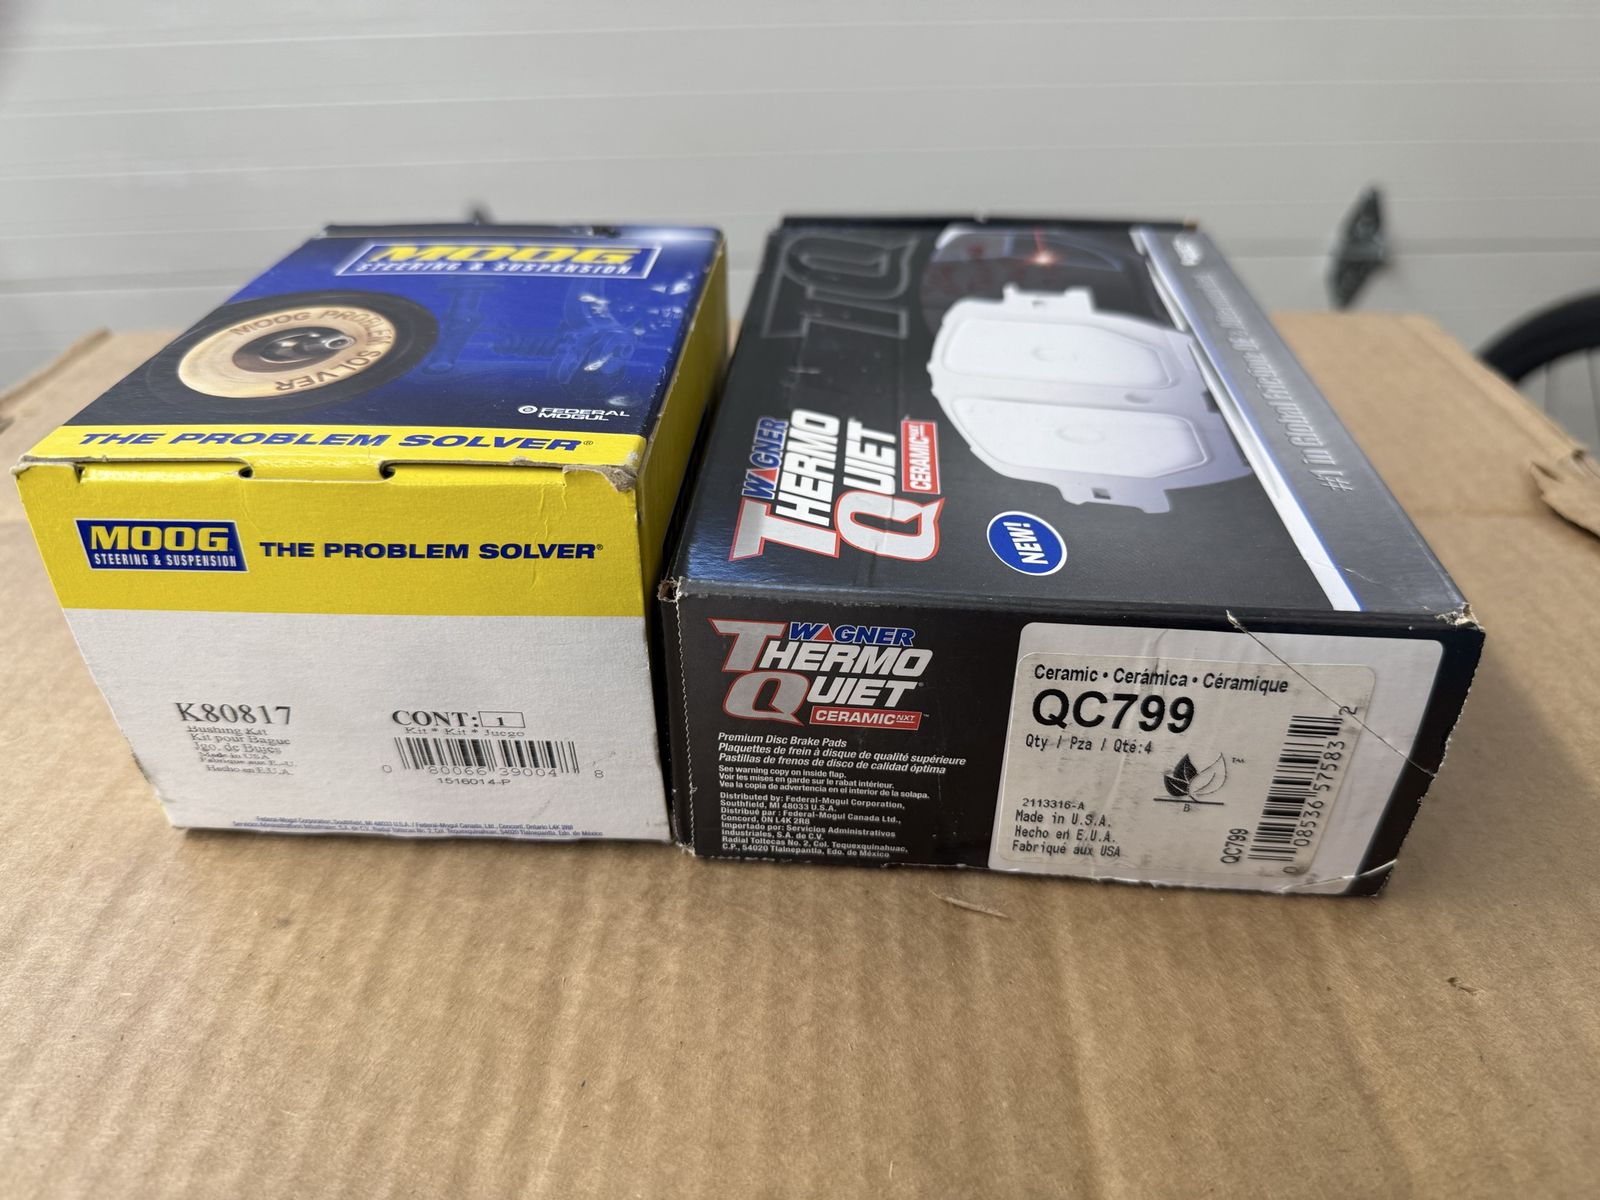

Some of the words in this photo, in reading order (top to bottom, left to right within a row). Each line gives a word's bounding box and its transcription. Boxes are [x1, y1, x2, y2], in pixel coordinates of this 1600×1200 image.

[368, 245, 641, 265] MOOG
[354, 262, 462, 273] STEERING
[469, 263, 479, 272] &
[496, 263, 634, 275] SUSPENSION
[230, 310, 312, 336] MOOG
[275, 349, 383, 392] SOLVER
[537, 412, 609, 422] MOGUL
[540, 407, 630, 418] FEDERAL
[79, 433, 166, 445] THE
[167, 433, 392, 447] PROBLEM
[741, 416, 789, 500] WAGNER
[728, 408, 841, 562] THERMO
[833, 416, 946, 563] QUIET
[90, 525, 230, 552] MOOG
[1002, 521, 1049, 565] NEW!
[259, 541, 316, 558] THE
[323, 542, 469, 559] PROBLEM
[94, 553, 149, 566] STEERING
[153, 553, 162, 566] &
[166, 554, 237, 567] SUSPENSION
[788, 621, 916, 647] WAGNER
[707, 617, 934, 677] THERMO
[1033, 663, 1099, 683] Ceramic
[1113, 667, 1188, 688] Cerámica
[1202, 672, 1289, 696] Céramique
[174, 701, 292, 726] K80817
[391, 709, 480, 728] CONT:
[496, 716, 505, 727] 1
[1032, 688, 1195, 734] QC799
[1339, 706, 1358, 716] 2
[186, 725, 243, 737] Bushing
[245, 727, 268, 736] Kit
[190, 733, 212, 741] Kit
[215, 735, 245, 743] pour
[246, 735, 291, 746] Bague
[445, 728, 467, 736] Kit
[718, 732, 764, 744] Premium
[765, 734, 788, 745] Disc
[790, 736, 820, 746] Brake
[822, 737, 848, 748] Pads
[223, 743, 240, 752] de
[1025, 733, 1048, 750] Qty
[1070, 736, 1093, 750] Pza
[718, 742, 772, 754] Plaquettes
[773, 745, 786, 755] de
[787, 746, 812, 756] frein
[813, 747, 820, 757] à
[822, 748, 857, 760] disque
[858, 750, 872, 760] de
[873, 752, 909, 763] qualité
[910, 754, 967, 766] supérieure
[382, 764, 393, 774] 0
[428, 765, 488, 776] 80066
[499, 767, 557, 778] 39004
[594, 769, 605, 779] 8
[718, 752, 761, 764] Pastillas
[763, 755, 776, 764] de
[777, 755, 810, 766] frenos
[811, 757, 825, 768] de
[826, 758, 854, 769] disco
[855, 760, 869, 770] de
[870, 762, 909, 772] calidad
[909, 764, 947, 775] óptima
[718, 764, 734, 773] See
[735, 766, 769, 776] warning
[769, 768, 790, 777] copy
[790, 769, 802, 777] on
[802, 769, 828, 778] inside
[828, 771, 847, 779] flap.
[1312, 740, 1346, 792] 57583
[437, 777, 512, 786] 1516014-P
[719, 772, 735, 780] Voir
[749, 774, 774, 783] mises
[787, 776, 811, 785] garde
[835, 779, 857, 787] rabat
[858, 780, 895, 789] intérieur.
[719, 780, 735, 788] Vea
[744, 782, 767, 791] copia
[767, 782, 779, 790] de
[779, 784, 827, 793] advertencia
[848, 787, 879, 796] interior
[900, 791, 931, 800] solapa.
[720, 791, 768, 801] Distributed
[770, 794, 784, 803] by:
[785, 795, 849, 806] Federal-Mogul
[850, 799, 906, 810] Corporation,
[720, 799, 768, 809] Southfield,
[782, 802, 809, 810] 48033
[810, 804, 837, 812] U.S.A.
[1022, 797, 1085, 811] 2113316-A
[720, 806, 760, 815] Distribué
[783, 810, 846, 820] Federal-Mogul
[847, 813, 880, 822] Canada
[881, 816, 902, 825] Ltd.,
[720, 813, 760, 823] Concord,
[775, 816, 792, 824] L4K
[793, 817, 810, 825] 2R8
[1015, 809, 1044, 823] Made
[1052, 812, 1065, 824] in
[1071, 813, 1112, 828] U.S.A.
[1293, 800, 1325, 847] 08536
[721, 821, 766, 830] Importado
[767, 824, 785, 832] por:
[786, 824, 826, 833] Servicios
[827, 826, 896, 837] Administrativos
[776, 831, 794, 839] S.A.
[808, 833, 825, 841] C.V.
[1014, 825, 1049, 839] Hecho
[1055, 829, 1070, 840] en
[1075, 829, 1116, 843] E.U.A.
[721, 835, 749, 844] Radial
[750, 837, 786, 846] Toltecas
[813, 840, 830, 848] Col.
[831, 841, 908, 853] Tequexquinahuac,
[722, 842, 741, 851] C.P.,
[741, 844, 769, 852] 54020
[826, 847, 846, 855] Edo.
[858, 849, 891, 858] México
[1072, 847, 1093, 856] aux
[1100, 845, 1121, 858] USA
[1220, 828, 1249, 865] QC799
